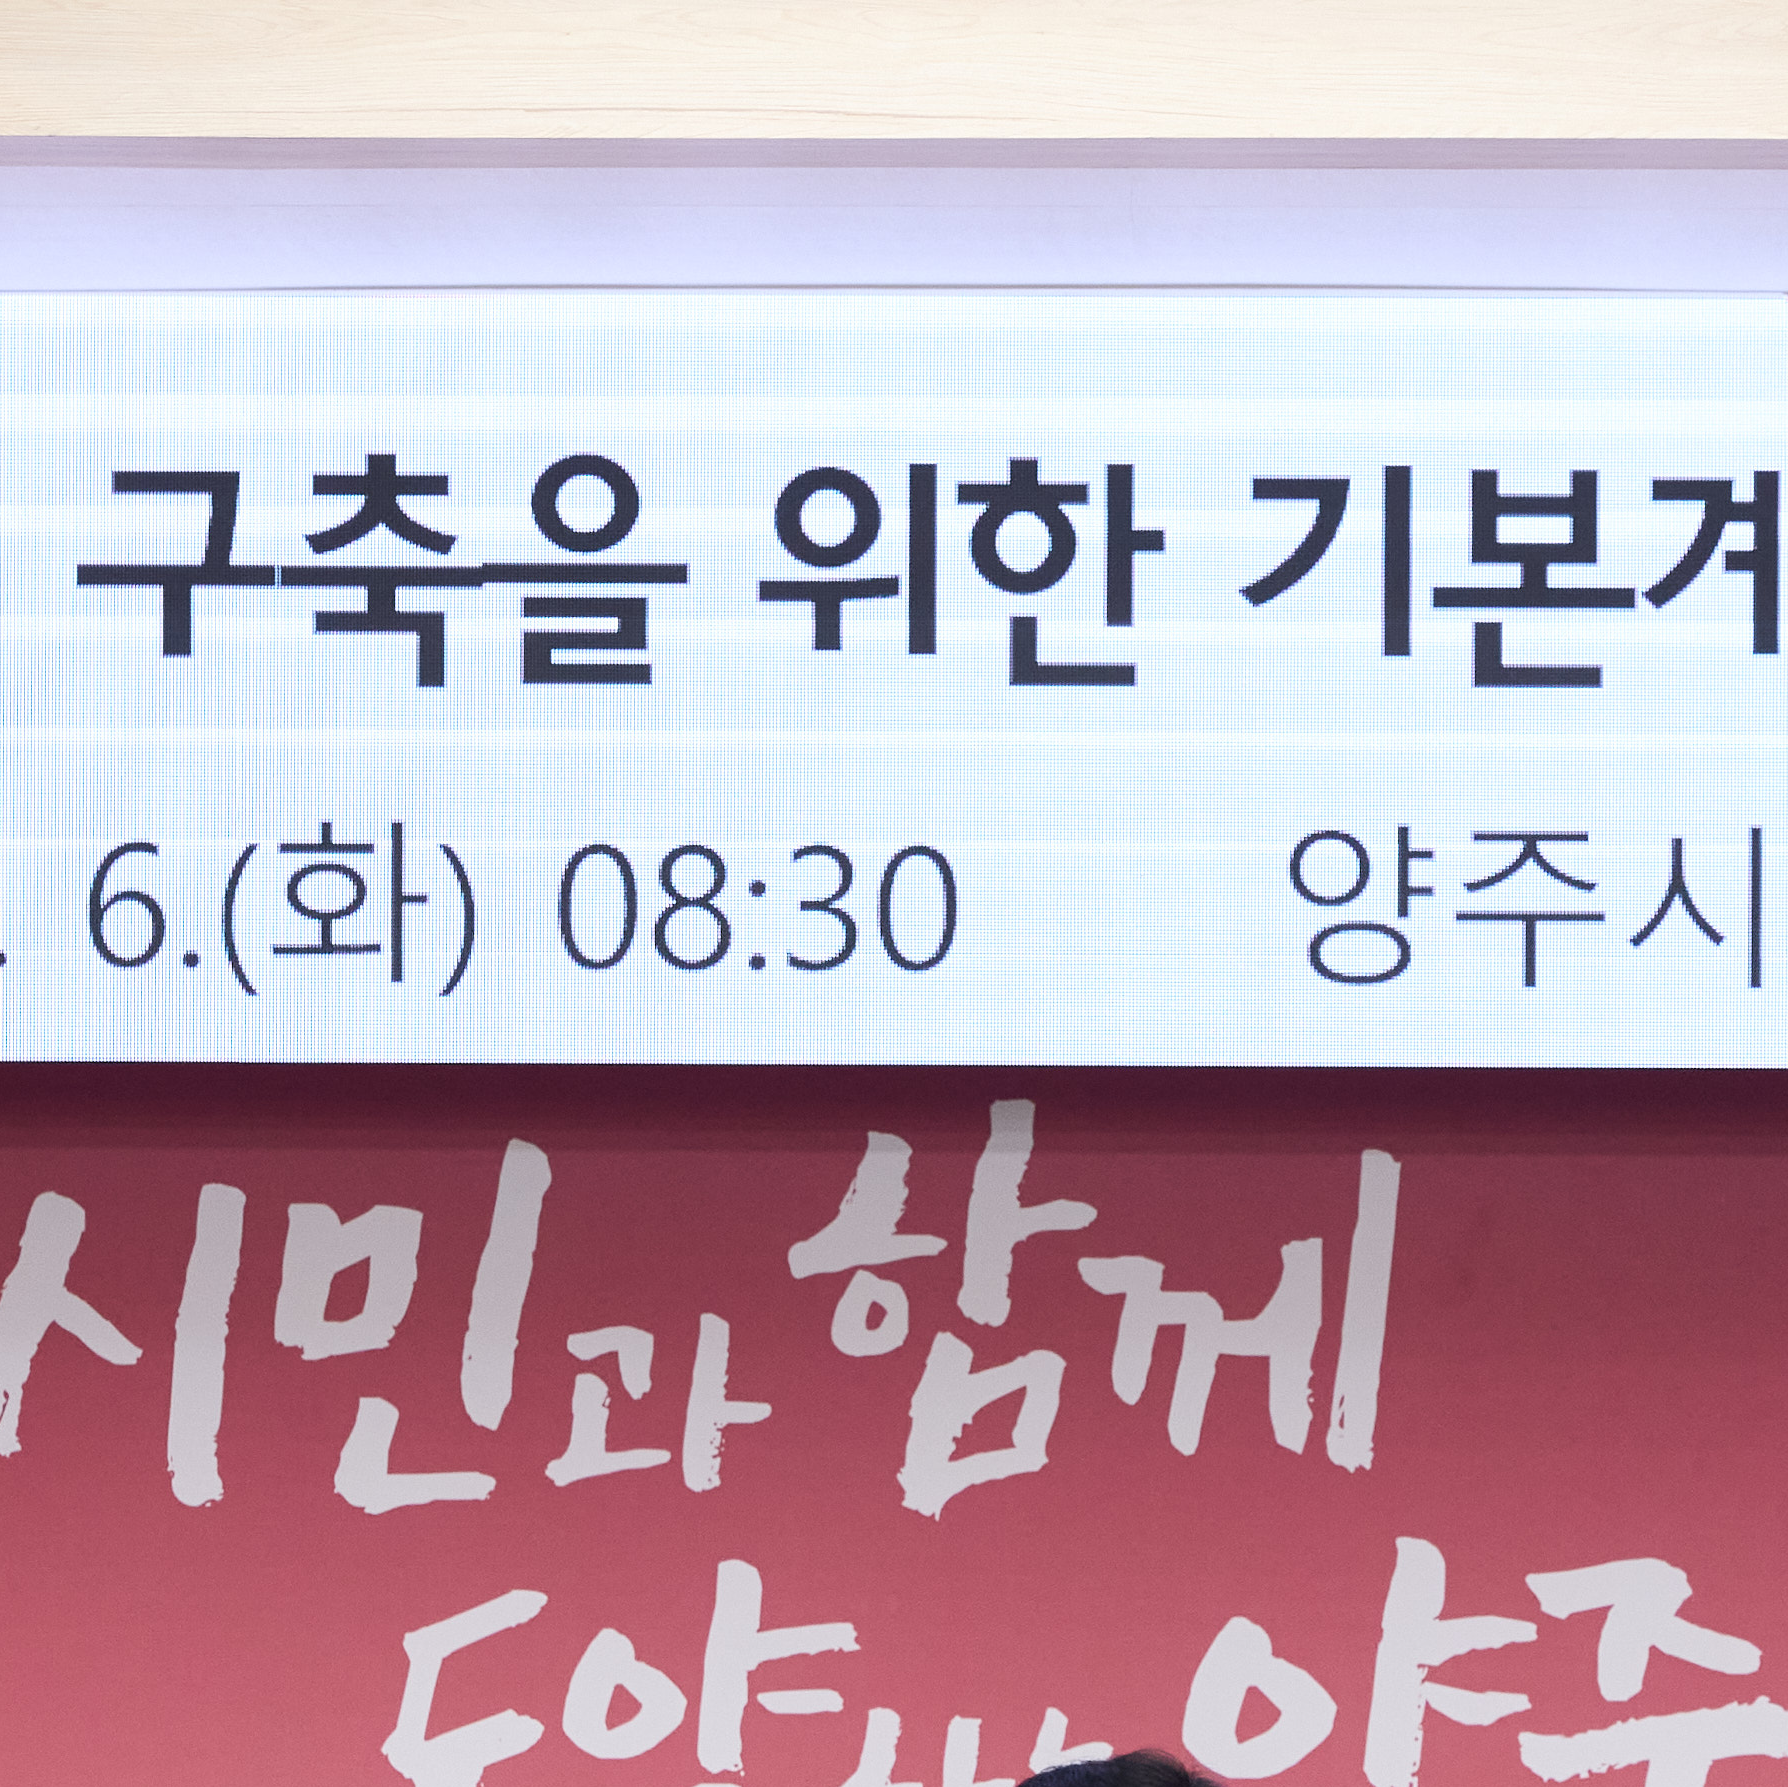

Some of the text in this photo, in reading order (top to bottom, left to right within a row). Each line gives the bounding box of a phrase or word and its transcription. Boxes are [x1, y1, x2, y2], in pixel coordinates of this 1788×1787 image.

[75, 453, 689, 688] 구축을
[758, 458, 1165, 686] 위한
[87, 821, 475, 995] 6.(화)
[557, 842, 957, 972] 08:30
[787, 1098, 1403, 1520] 함께
